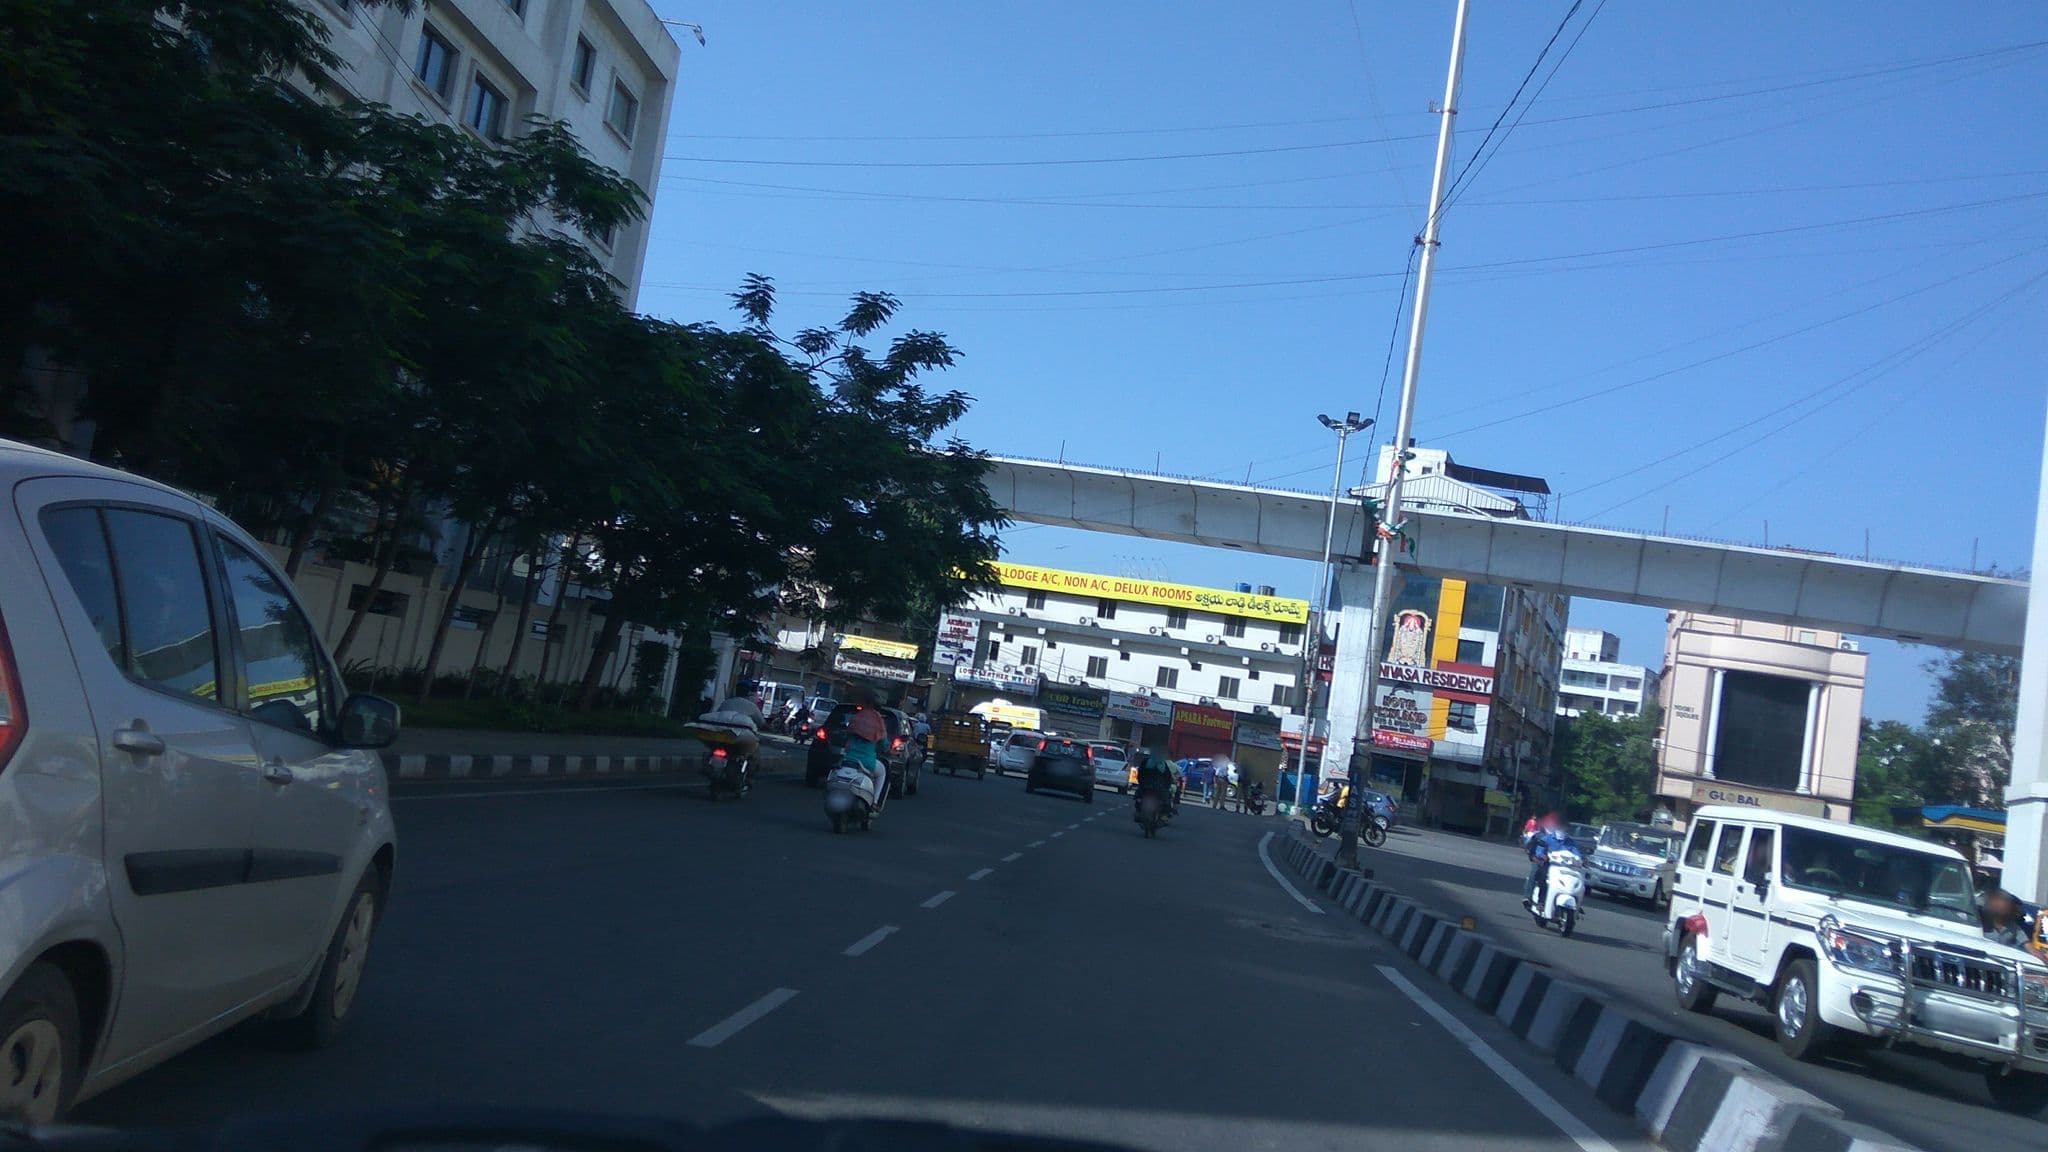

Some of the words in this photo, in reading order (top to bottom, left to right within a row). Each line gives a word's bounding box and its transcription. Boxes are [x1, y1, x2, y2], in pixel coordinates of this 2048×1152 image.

[1004, 568, 1038, 582] LODGE
[1040, 573, 1060, 586] A/C,
[1064, 576, 1088, 589] NON
[1090, 579, 1110, 593] A/C,
[1114, 582, 1149, 597] DELUX
[1152, 586, 1192, 601] ROOMS
[1423, 670, 1491, 692] RESIDENCY
[1176, 709, 1202, 725] APSARA
[1203, 715, 1232, 730] Footwear
[1709, 790, 1761, 807] GLOBAL
